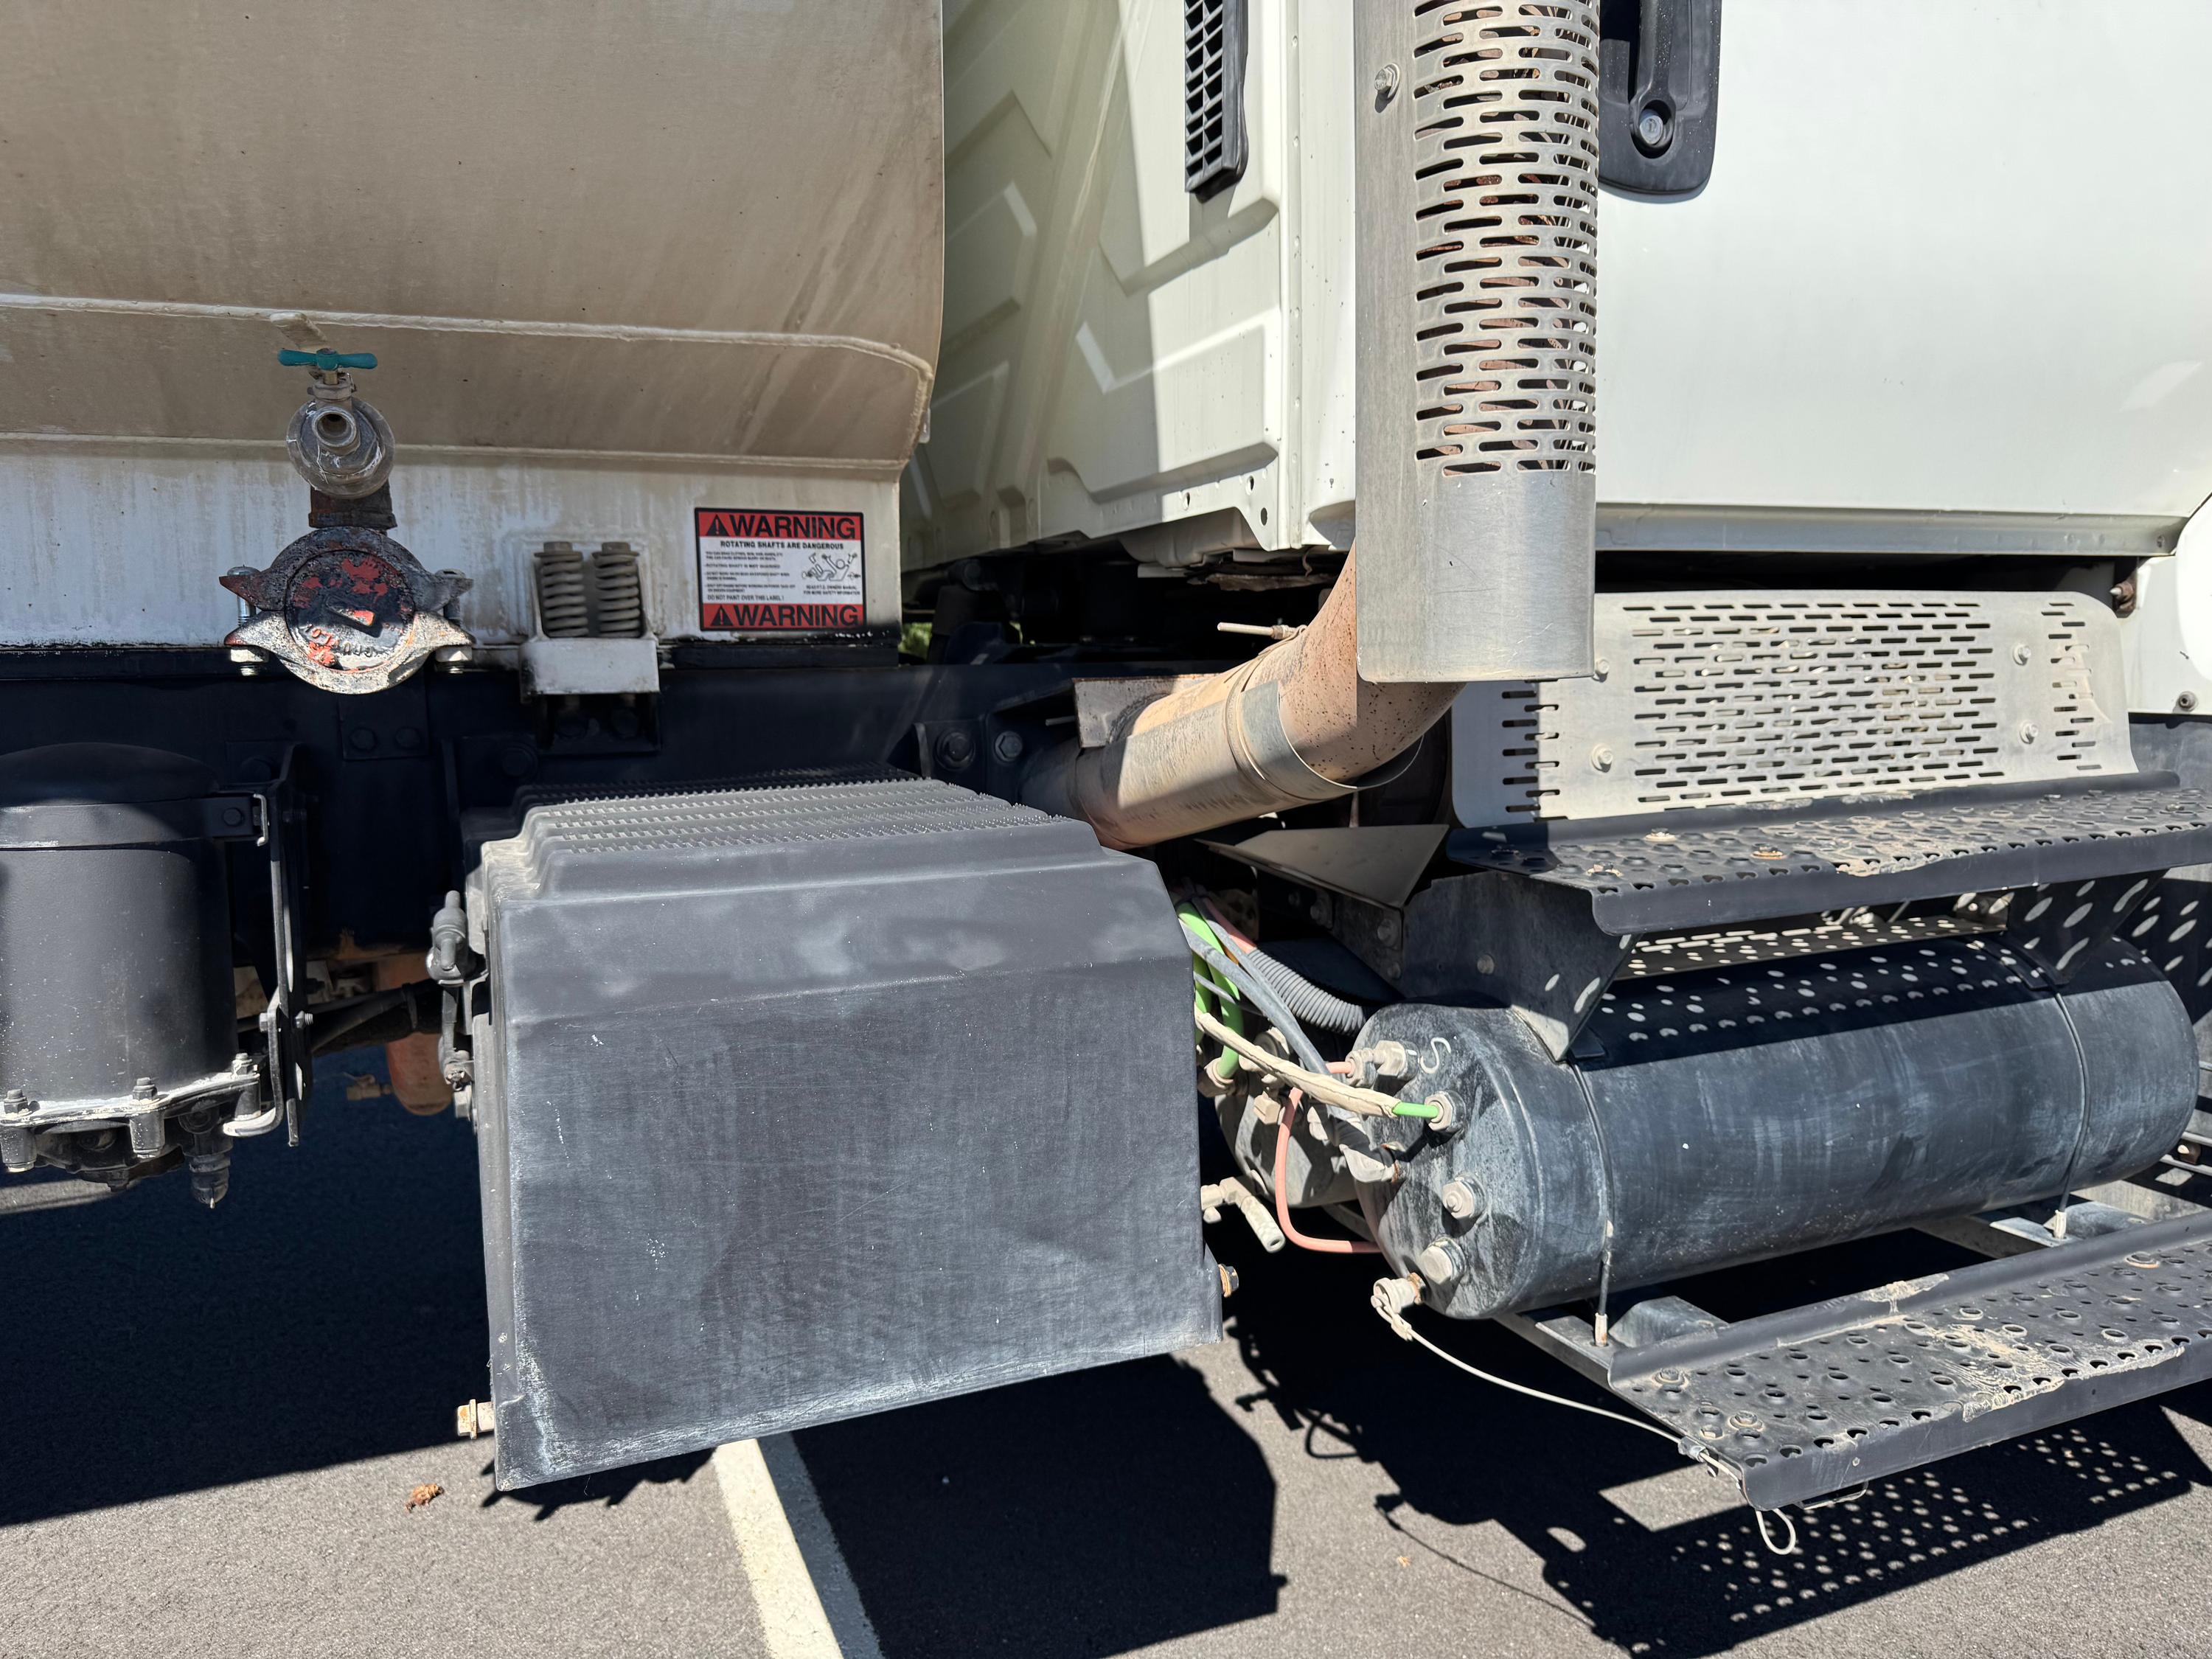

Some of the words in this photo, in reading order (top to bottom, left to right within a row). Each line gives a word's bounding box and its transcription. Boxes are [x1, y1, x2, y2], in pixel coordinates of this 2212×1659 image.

[728, 515, 856, 540] WARNING
[720, 540, 756, 549] ROTATING
[733, 605, 859, 627] WARNING
